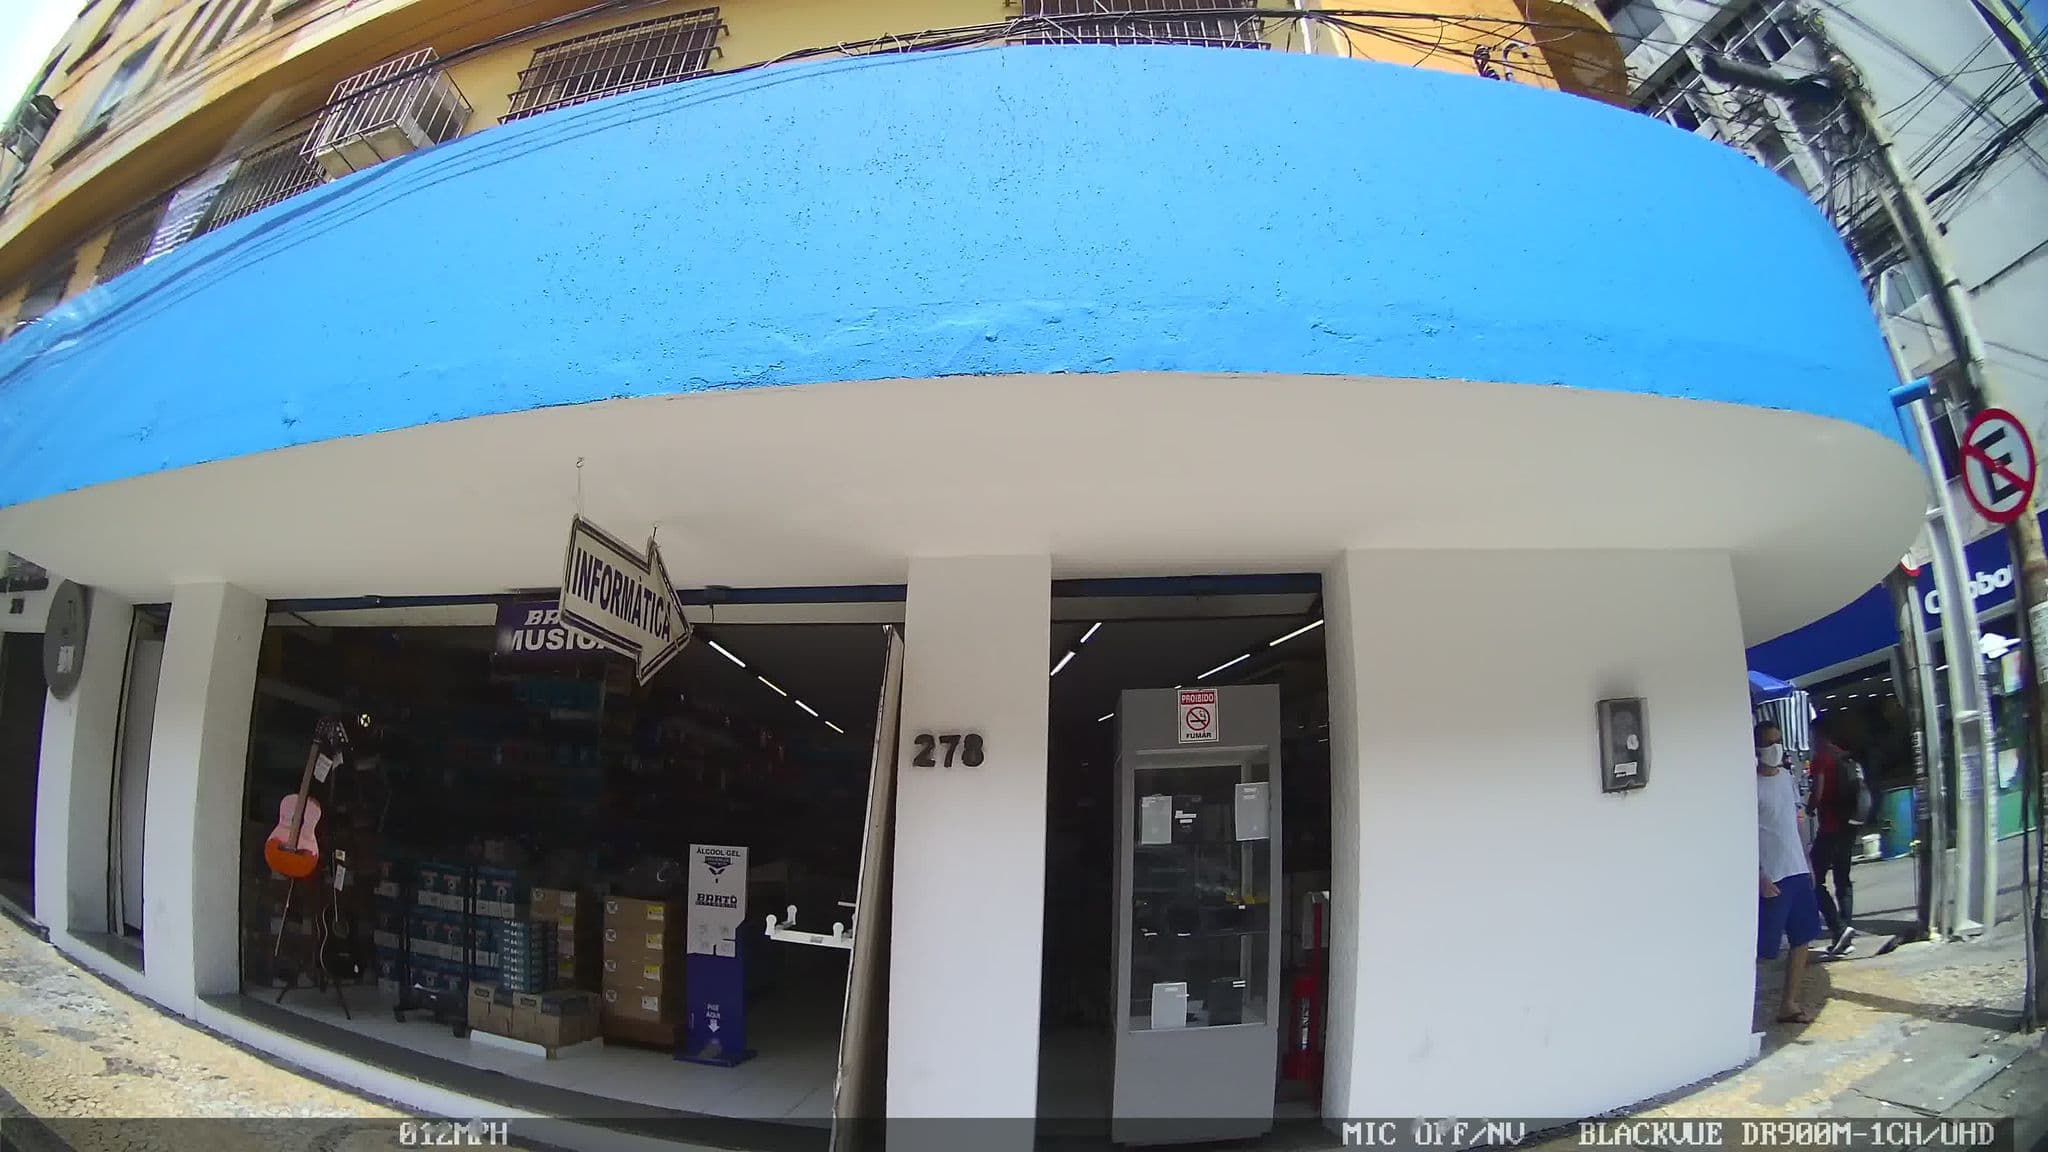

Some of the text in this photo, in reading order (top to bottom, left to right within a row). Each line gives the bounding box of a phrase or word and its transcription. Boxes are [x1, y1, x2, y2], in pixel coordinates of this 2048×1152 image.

[1976, 427, 2021, 504] E
[570, 547, 672, 643] INFORMÁTICA
[1181, 693, 1214, 704] PROIBIDO
[912, 733, 985, 767] 278
